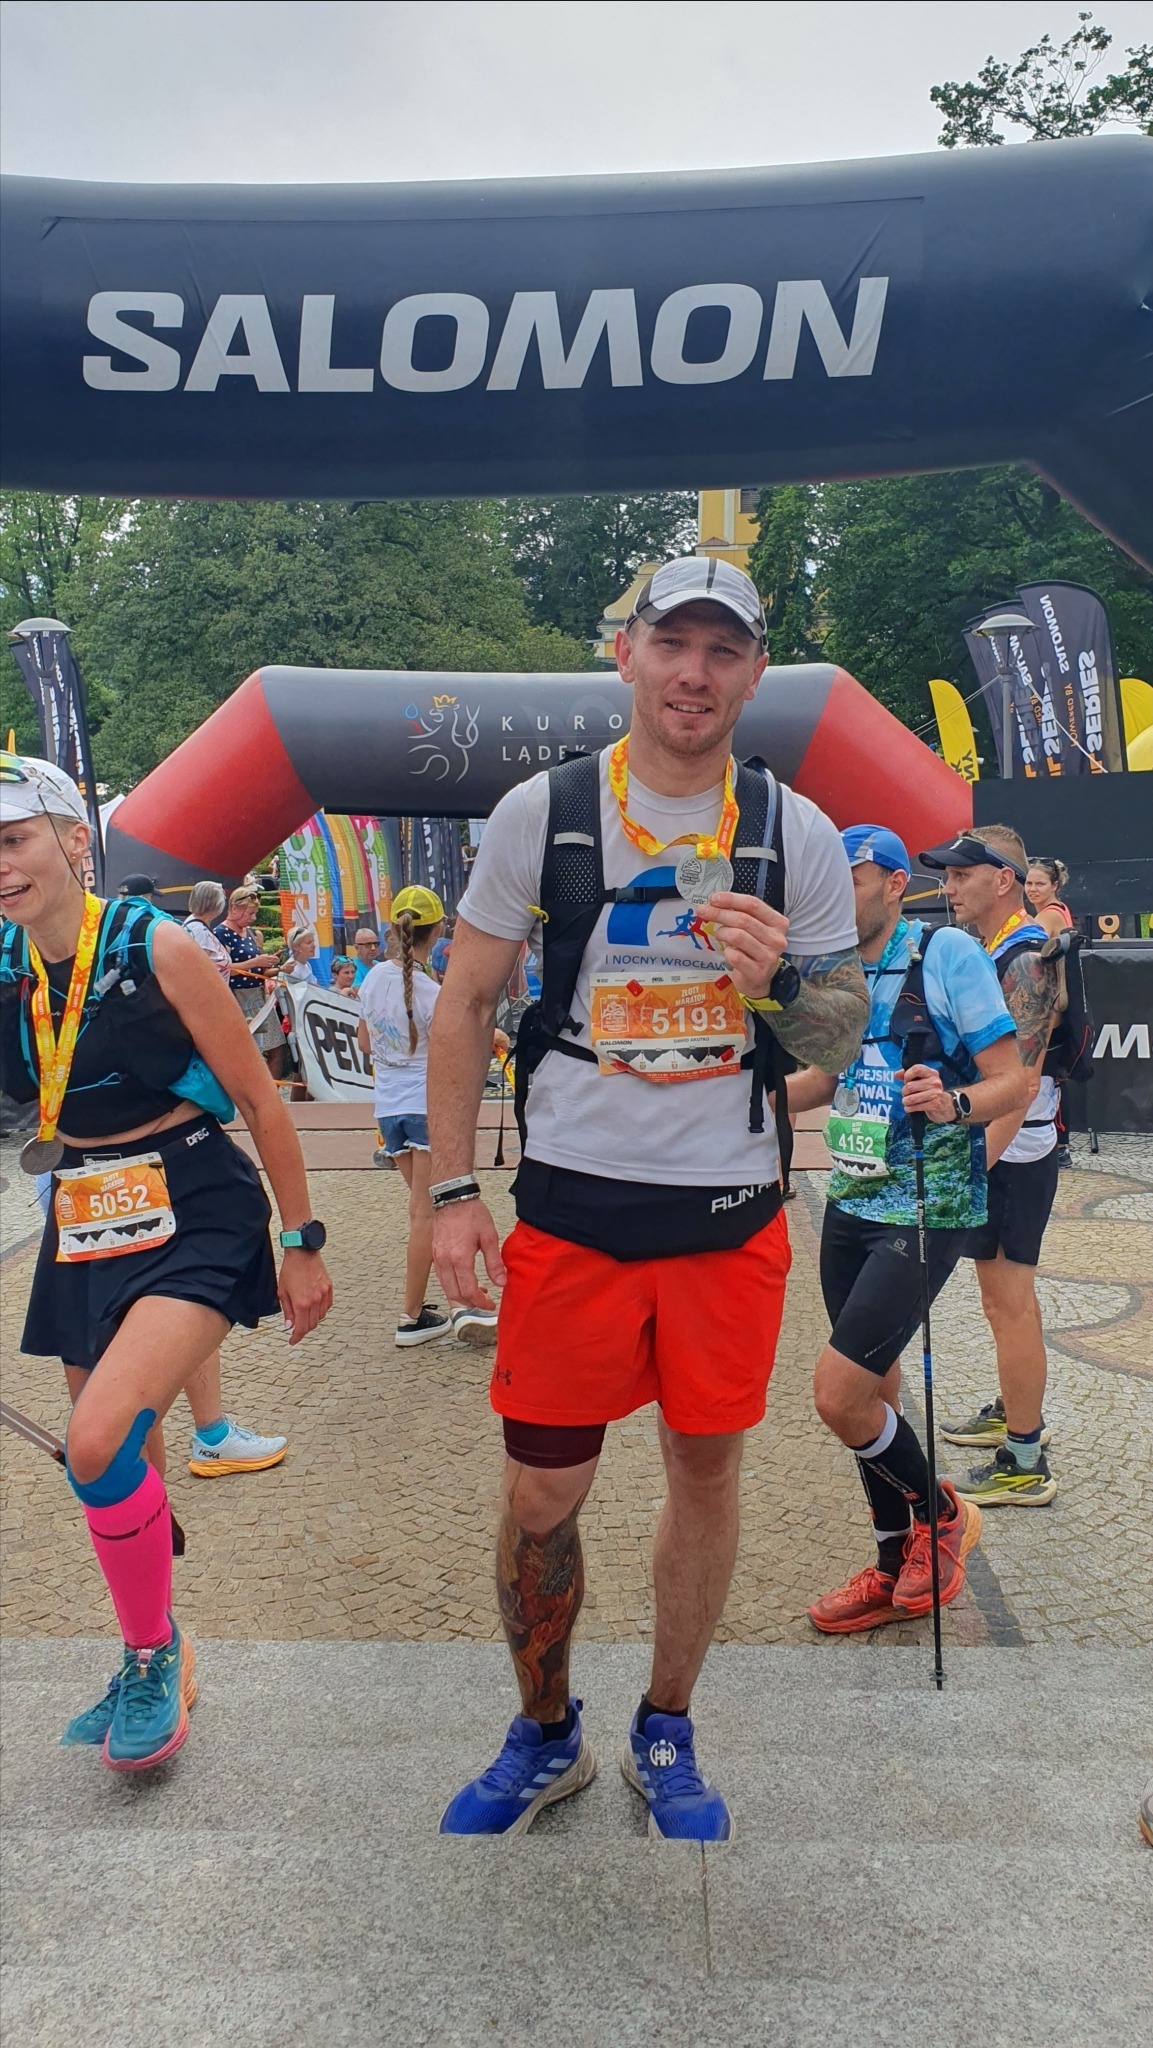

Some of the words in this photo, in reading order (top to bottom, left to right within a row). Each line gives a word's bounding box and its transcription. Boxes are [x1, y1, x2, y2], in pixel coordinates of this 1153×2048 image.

[83, 277, 889, 393] SALOMON
[502, 714, 623, 731] KURO
[612, 954, 657, 965] NOCNY
[675, 993, 706, 1007] MARATON
[652, 1005, 727, 1035] 5193
[838, 1133, 874, 1154] 4152
[89, 1184, 151, 1218] 5052
[711, 1185, 755, 1213] RUN
